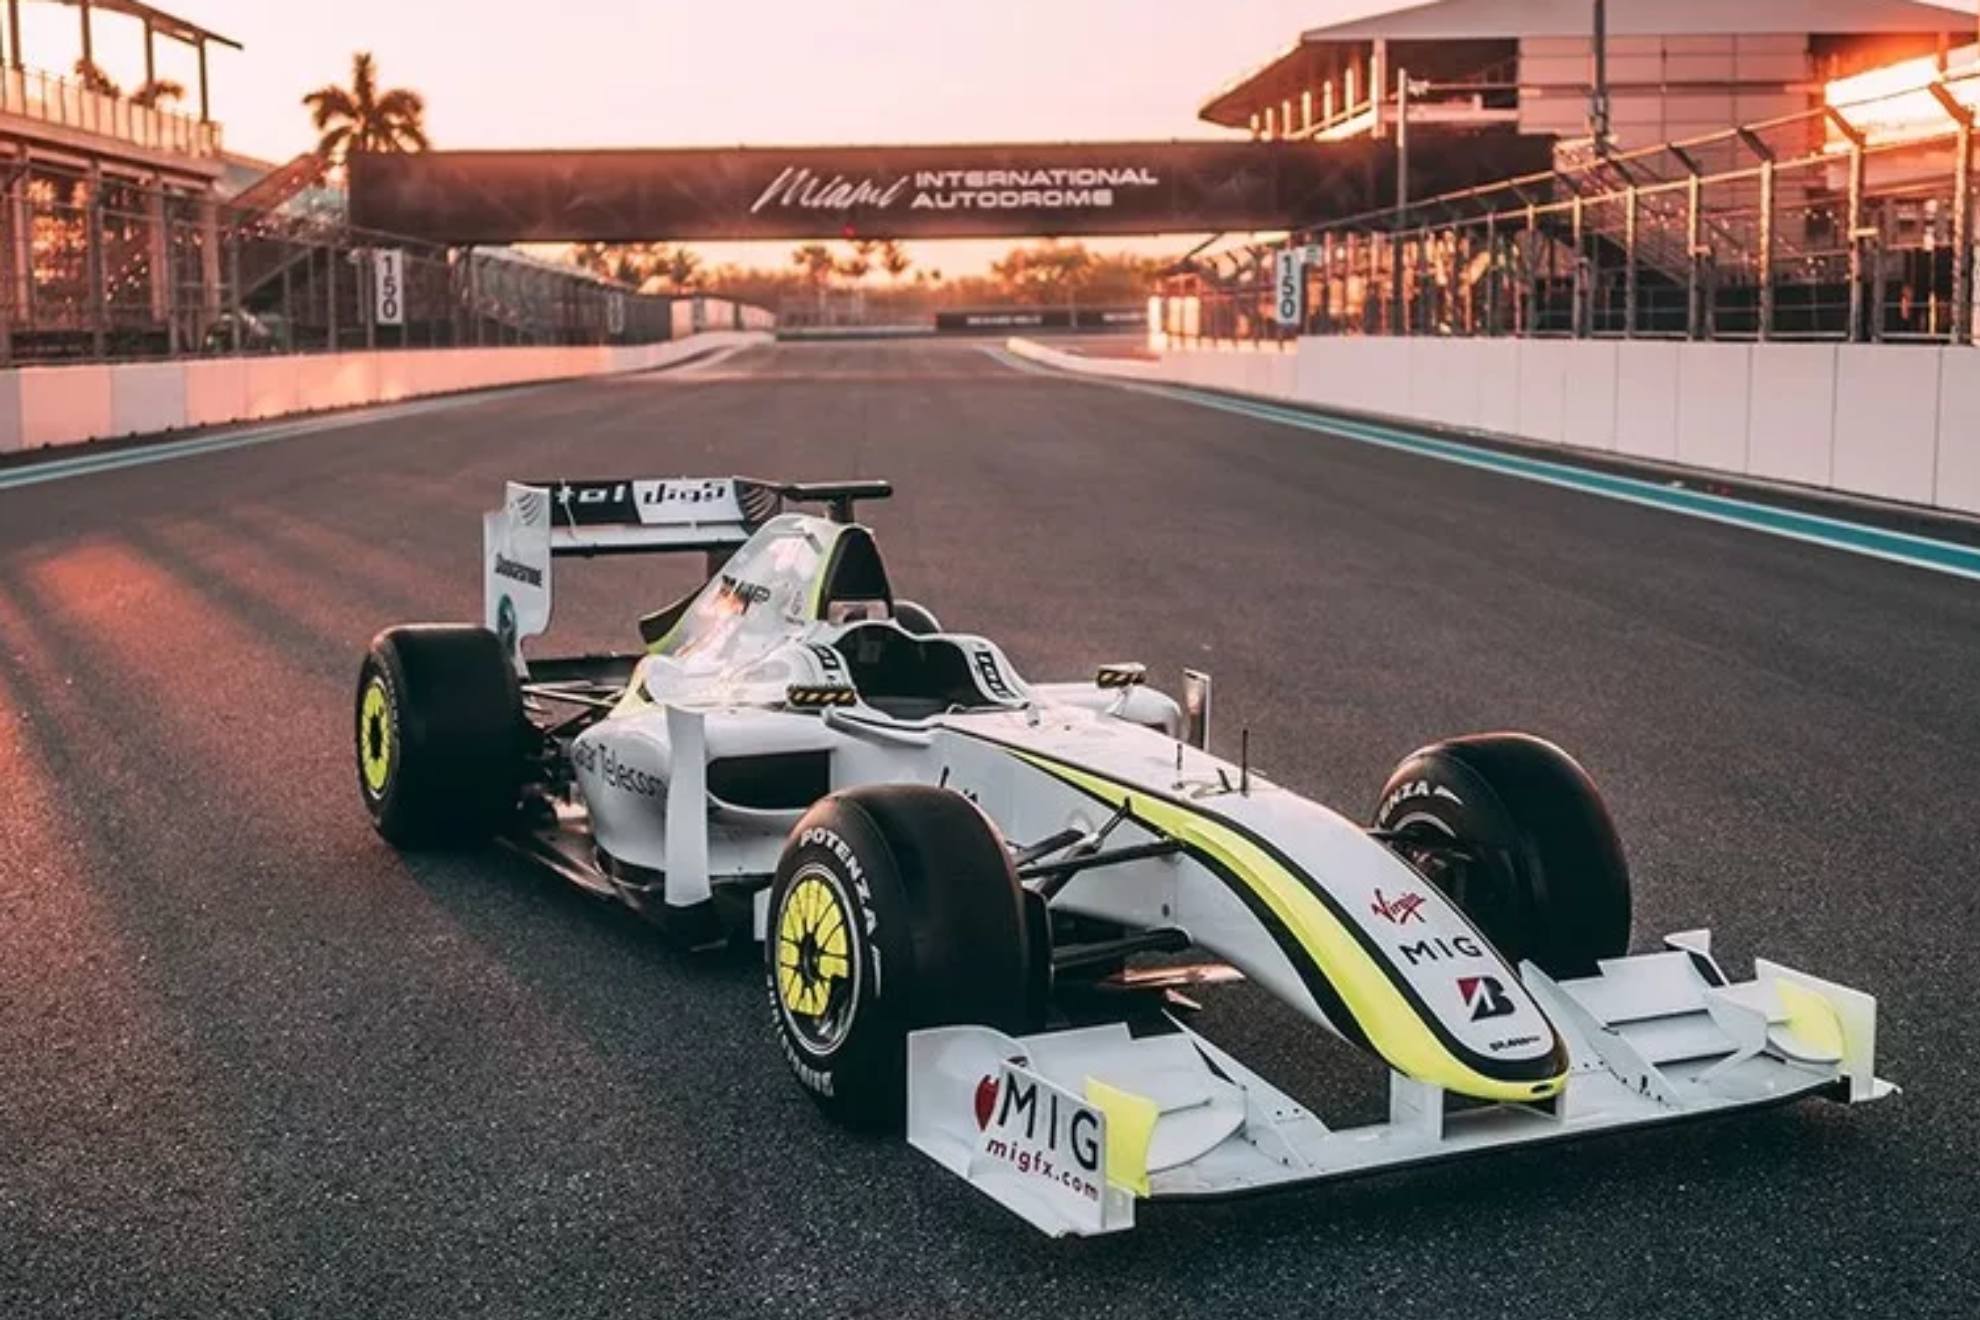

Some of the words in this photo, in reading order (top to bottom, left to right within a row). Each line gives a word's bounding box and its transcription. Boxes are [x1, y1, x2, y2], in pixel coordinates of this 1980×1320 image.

[751, 165, 907, 214] Miami
[915, 167, 1159, 188] INTERNATIONAL
[911, 188, 1114, 209] AUTODROME
[383, 255, 398, 319] 150
[1281, 255, 1296, 319] 150
[800, 827, 877, 936] POTENZA
[1399, 936, 1484, 966] MIG
[998, 1071, 1099, 1171] MIG
[985, 1139, 1099, 1201] migfx.com
